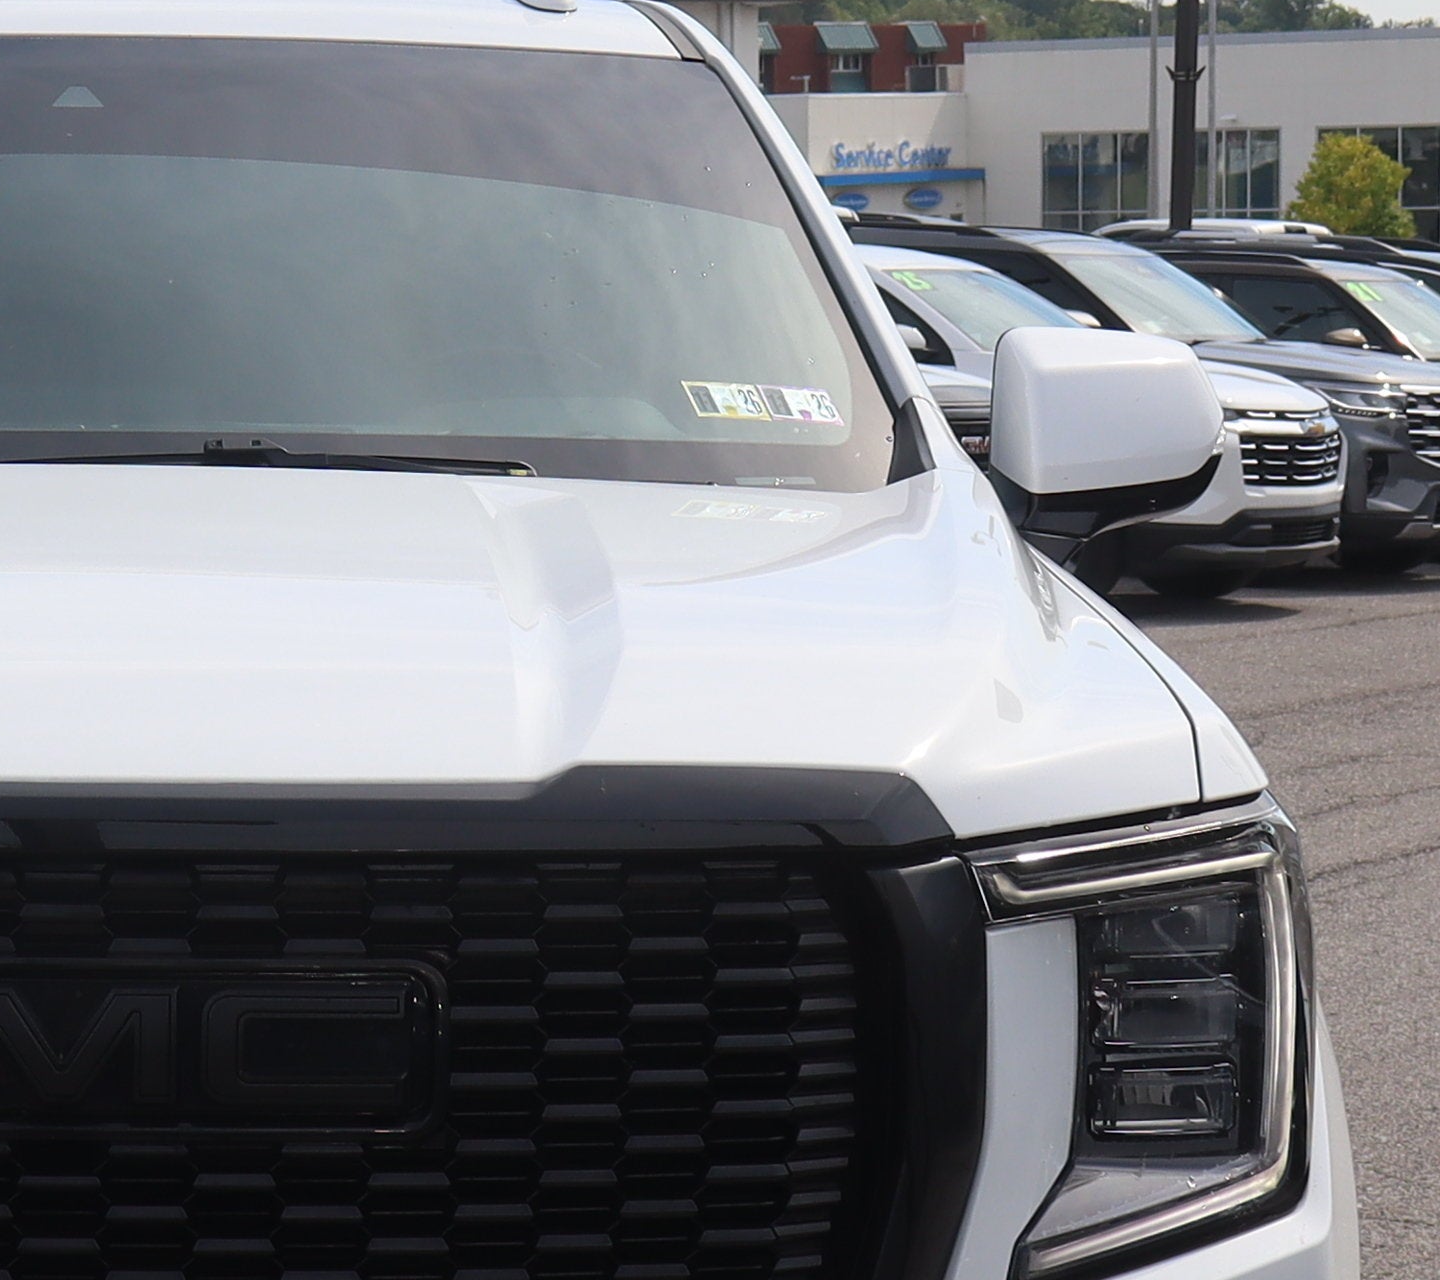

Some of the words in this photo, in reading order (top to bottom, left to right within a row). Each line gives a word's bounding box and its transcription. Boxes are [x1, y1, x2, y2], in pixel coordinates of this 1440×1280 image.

[832, 142, 894, 170] Service
[897, 140, 952, 168] Center
[737, 389, 763, 415] 26
[811, 393, 836, 419] 26
